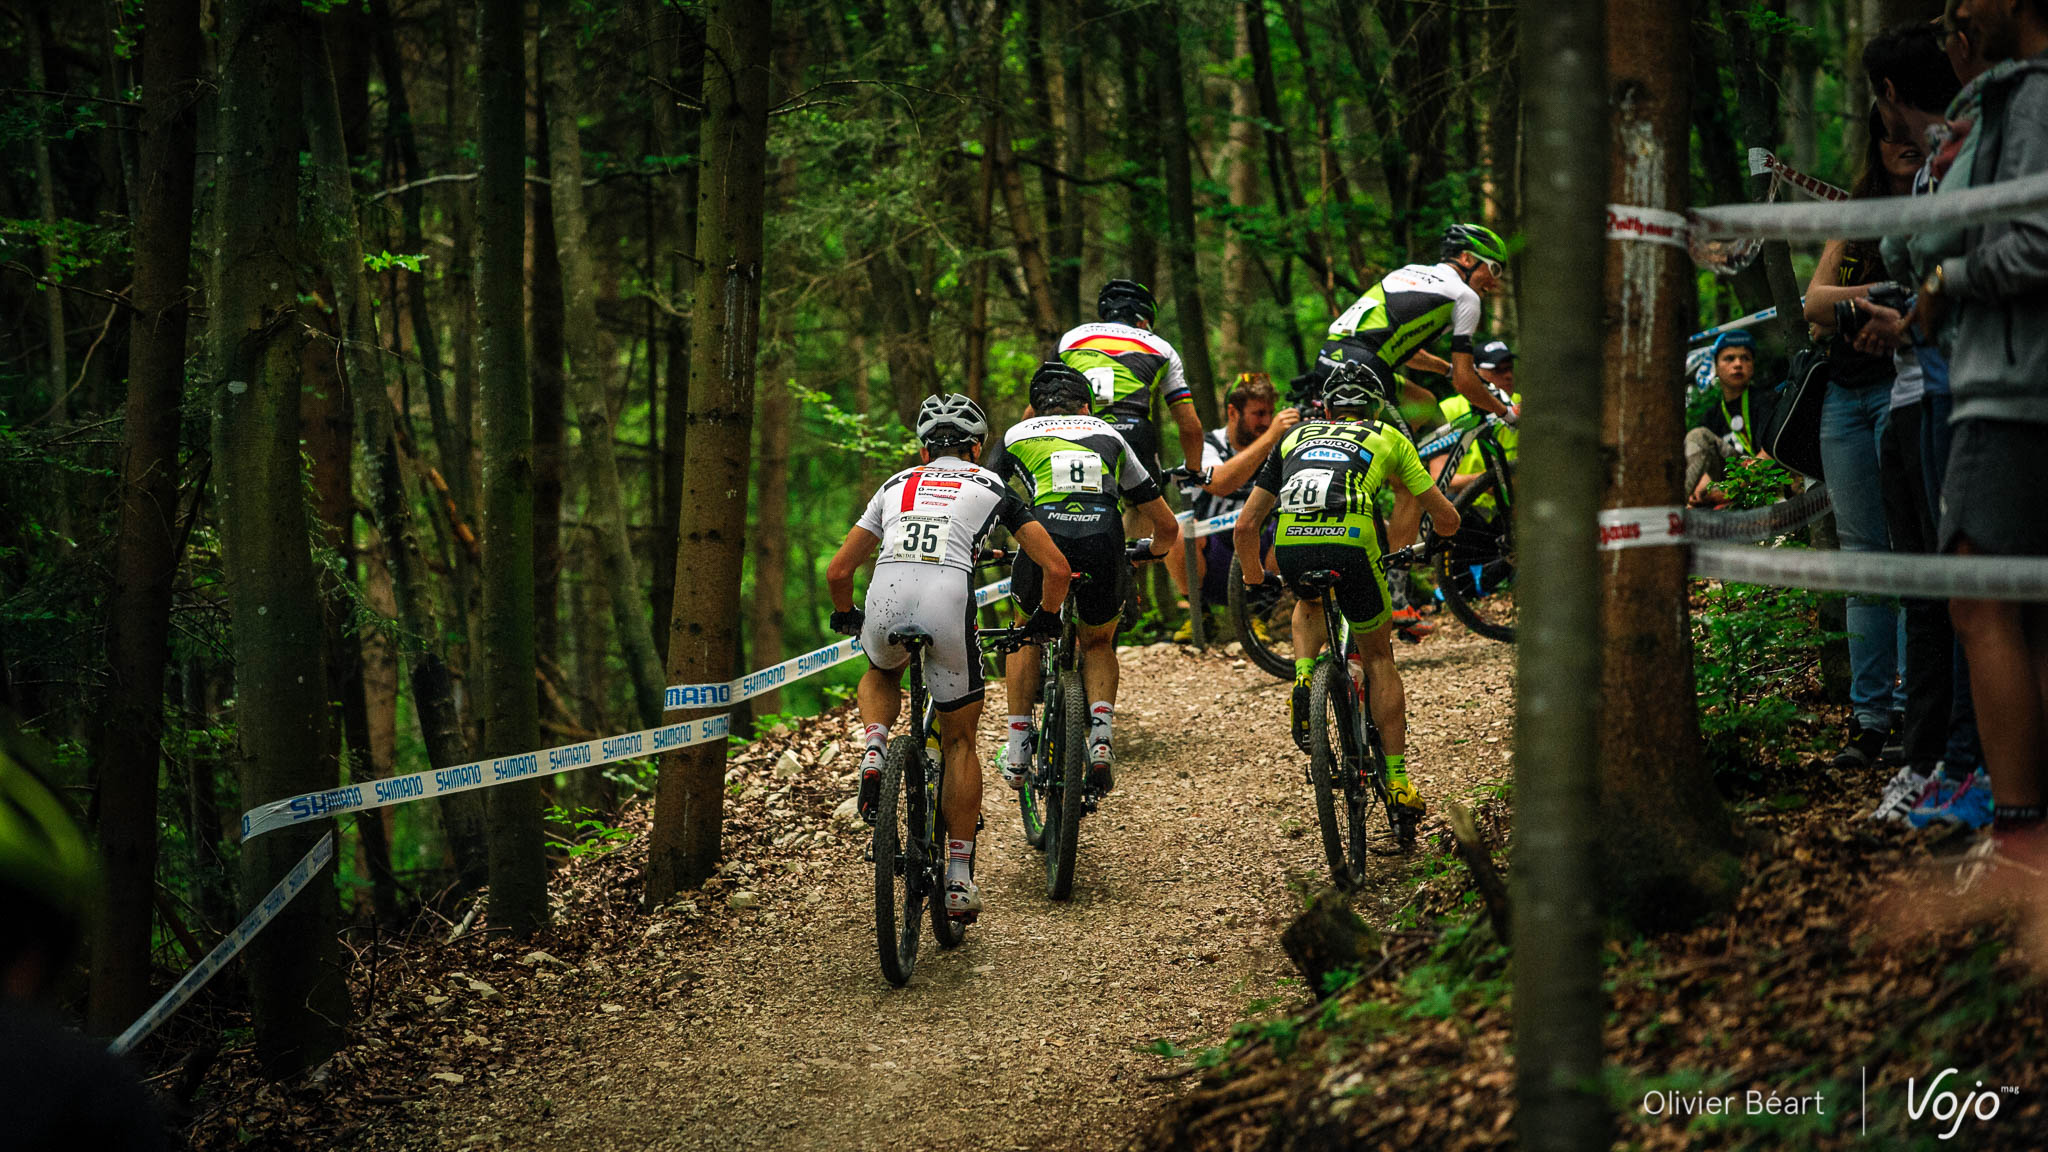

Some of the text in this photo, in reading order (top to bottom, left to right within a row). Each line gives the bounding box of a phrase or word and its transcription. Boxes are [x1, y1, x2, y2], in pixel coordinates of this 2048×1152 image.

[1296, 425, 1371, 444] BH
[1070, 459, 1085, 483] 8
[1289, 479, 1319, 505] 28
[1048, 512, 1101, 522] MERIDA
[903, 522, 939, 553] 35
[665, 685, 730, 706] MANO
[743, 666, 785, 696] SHIMANO
[798, 646, 839, 676] SHIMANO
[290, 715, 728, 819] SHIMANO SHIMANO SHIMANO SHIMANO SHIMANO SHIMANO SHIMANO SHIMA
